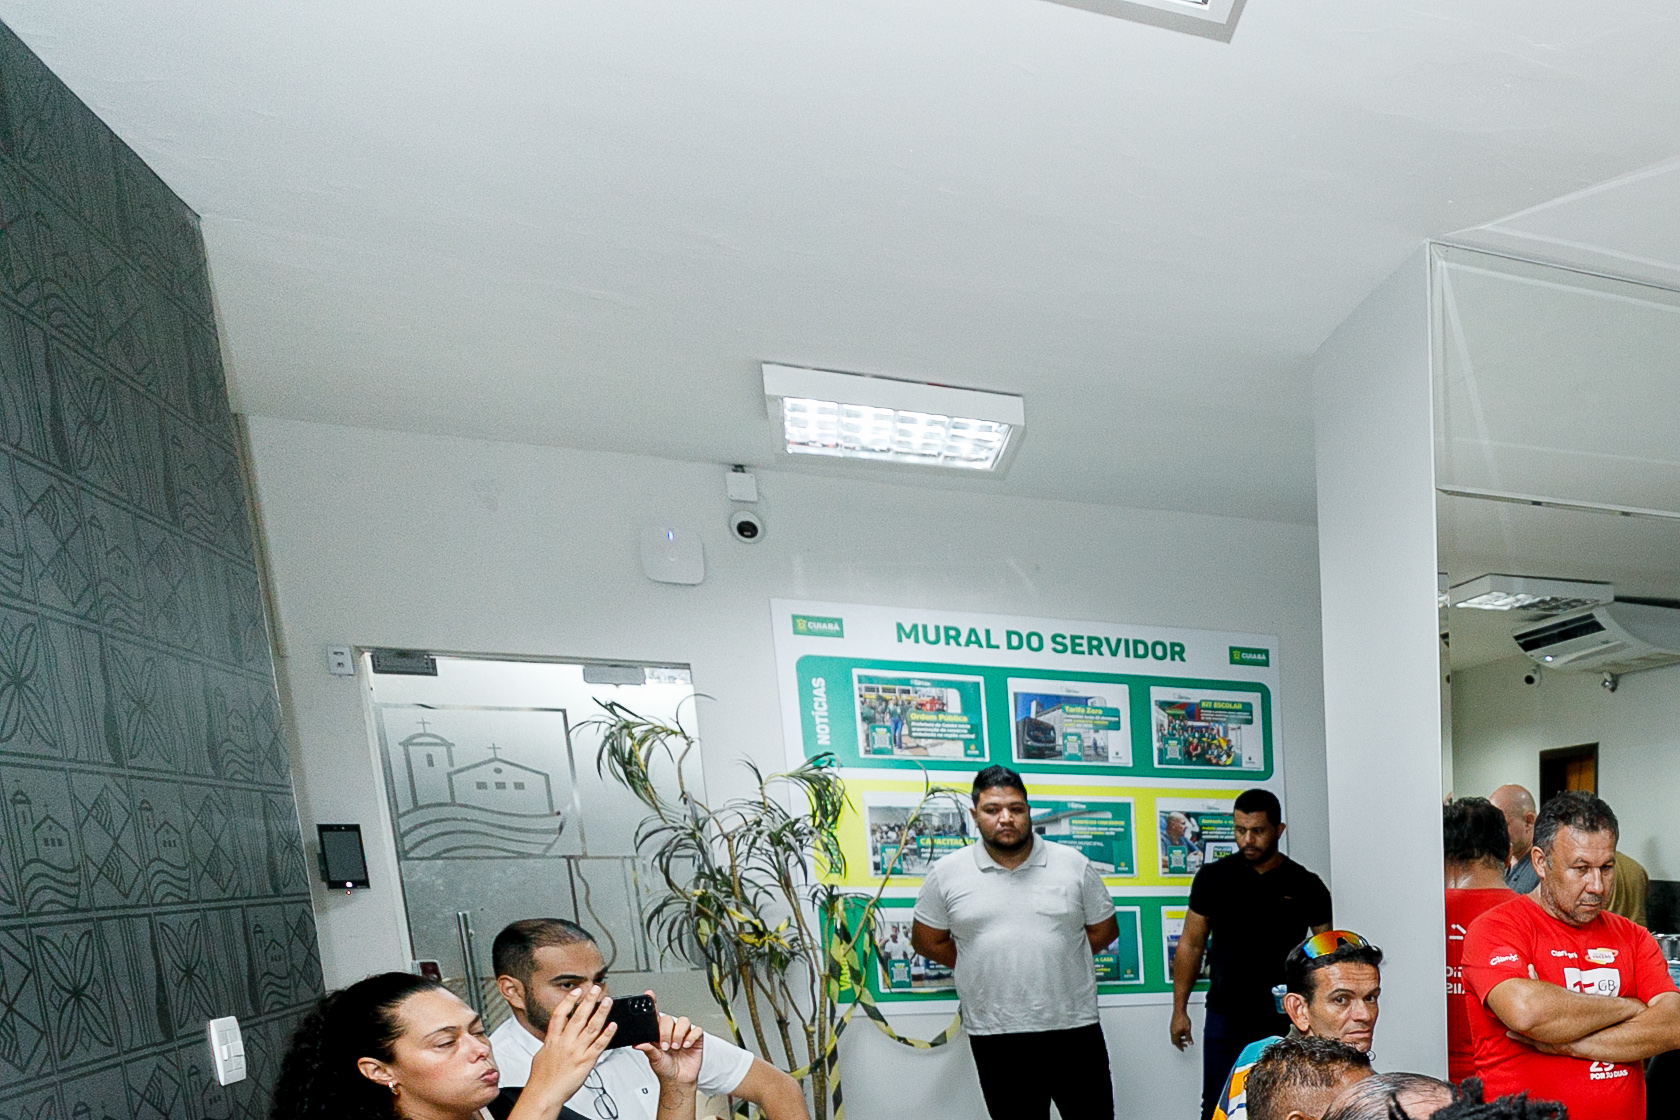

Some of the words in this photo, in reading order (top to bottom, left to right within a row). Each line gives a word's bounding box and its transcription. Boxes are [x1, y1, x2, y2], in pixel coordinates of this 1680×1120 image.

[807, 620, 841, 631] CUIABÁ
[896, 621, 1000, 650] MURAL
[1006, 629, 1044, 653] DO
[1051, 632, 1186, 663] SERVIDOR
[1241, 651, 1267, 661] CUIABÁ
[811, 676, 831, 746] NOTÍCIAS
[1064, 705, 1085, 714] Tarifa
[1086, 706, 1103, 715] Zero
[1213, 701, 1243, 710] ESCOLAR
[909, 712, 937, 721] Ordem
[938, 712, 968, 723] Pública
[1598, 979, 1615, 992] GB
[1590, 1071, 1605, 1080] POR
[1614, 1069, 1628, 1078] DIAS
